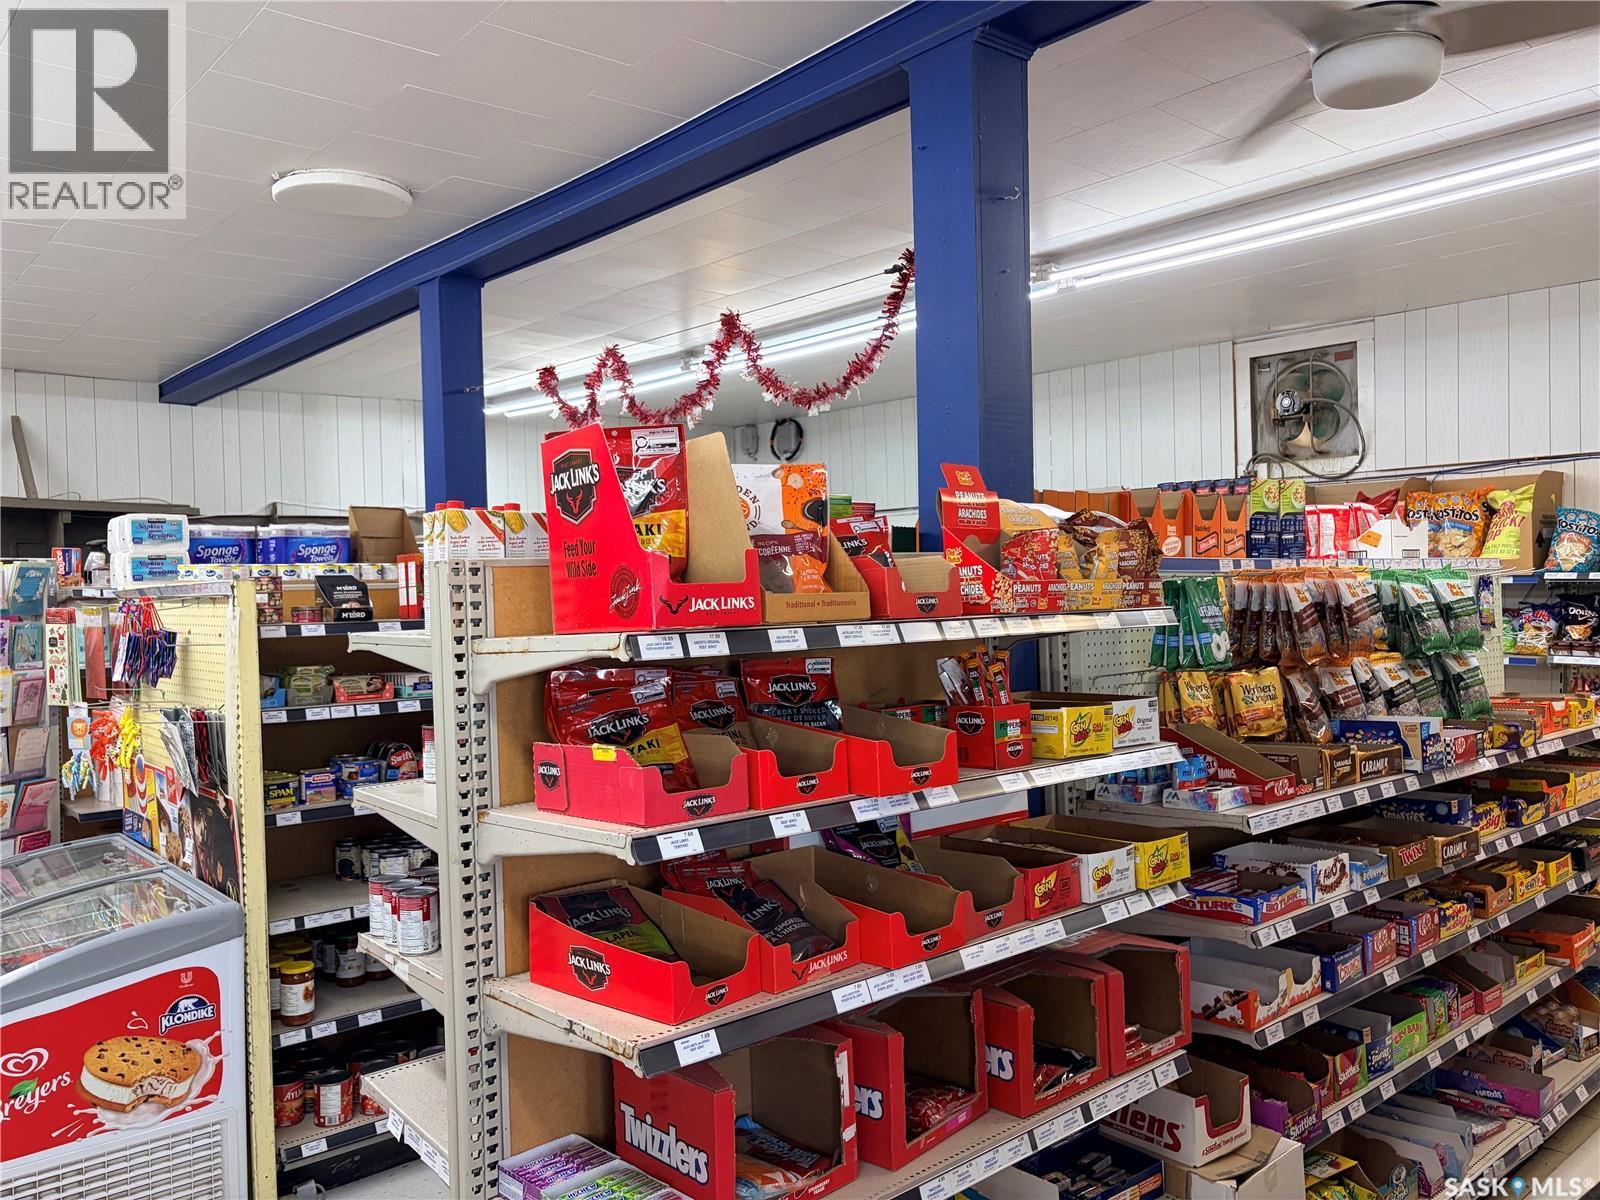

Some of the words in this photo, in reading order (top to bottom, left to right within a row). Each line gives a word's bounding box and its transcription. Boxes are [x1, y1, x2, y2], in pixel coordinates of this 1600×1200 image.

[550, 470, 572, 495] JACK
[570, 463, 600, 489] LINK'S
[958, 509, 987, 520] ARACHIDES
[196, 544, 240, 560] Sponge
[298, 543, 337, 557] Sponge
[563, 541, 579, 555] Feed
[579, 540, 596, 555] Your
[566, 563, 581, 579] Wild
[581, 562, 599, 577] Side.
[1013, 583, 1042, 594] PEANUTS
[689, 598, 720, 613] JACK
[720, 596, 756, 610] LINK'S
[785, 601, 816, 609] Traditional
[768, 682, 790, 693] JACK
[789, 681, 817, 691] LINK'S
[1240, 682, 1277, 694] Werther's
[1251, 692, 1278, 704] Original
[690, 708, 711, 720] JACK
[711, 705, 735, 718] LINK'S
[1113, 713, 1130, 727] CORN
[588, 724, 617, 739] JACK
[616, 713, 650, 729] LINK'S
[1071, 720, 1087, 735] CORN
[390, 750, 413, 767] Swift
[537, 765, 549, 775] JACK
[796, 780, 808, 788] JACK
[269, 787, 294, 799] SPAM
[683, 798, 699, 809] JACK
[698, 796, 716, 806] LINK'S
[1149, 851, 1164, 868] CORN
[1092, 865, 1110, 881] CORN
[706, 879, 724, 889] JACK
[1035, 878, 1053, 895] CORN
[1198, 899, 1235, 911] TURK
[567, 913, 597, 928] JACK
[568, 952, 588, 968] JACK
[586, 959, 611, 976] LINK'S
[809, 960, 827, 973] JACK
[826, 951, 848, 969] LINK'S
[705, 991, 715, 1001] JACK
[161, 1005, 215, 1033] KLONDIKE
[1338, 1063, 1360, 1085] Skittles
[1289, 1113, 1317, 1140] Skittles
[620, 1101, 709, 1185] Twizzlers
